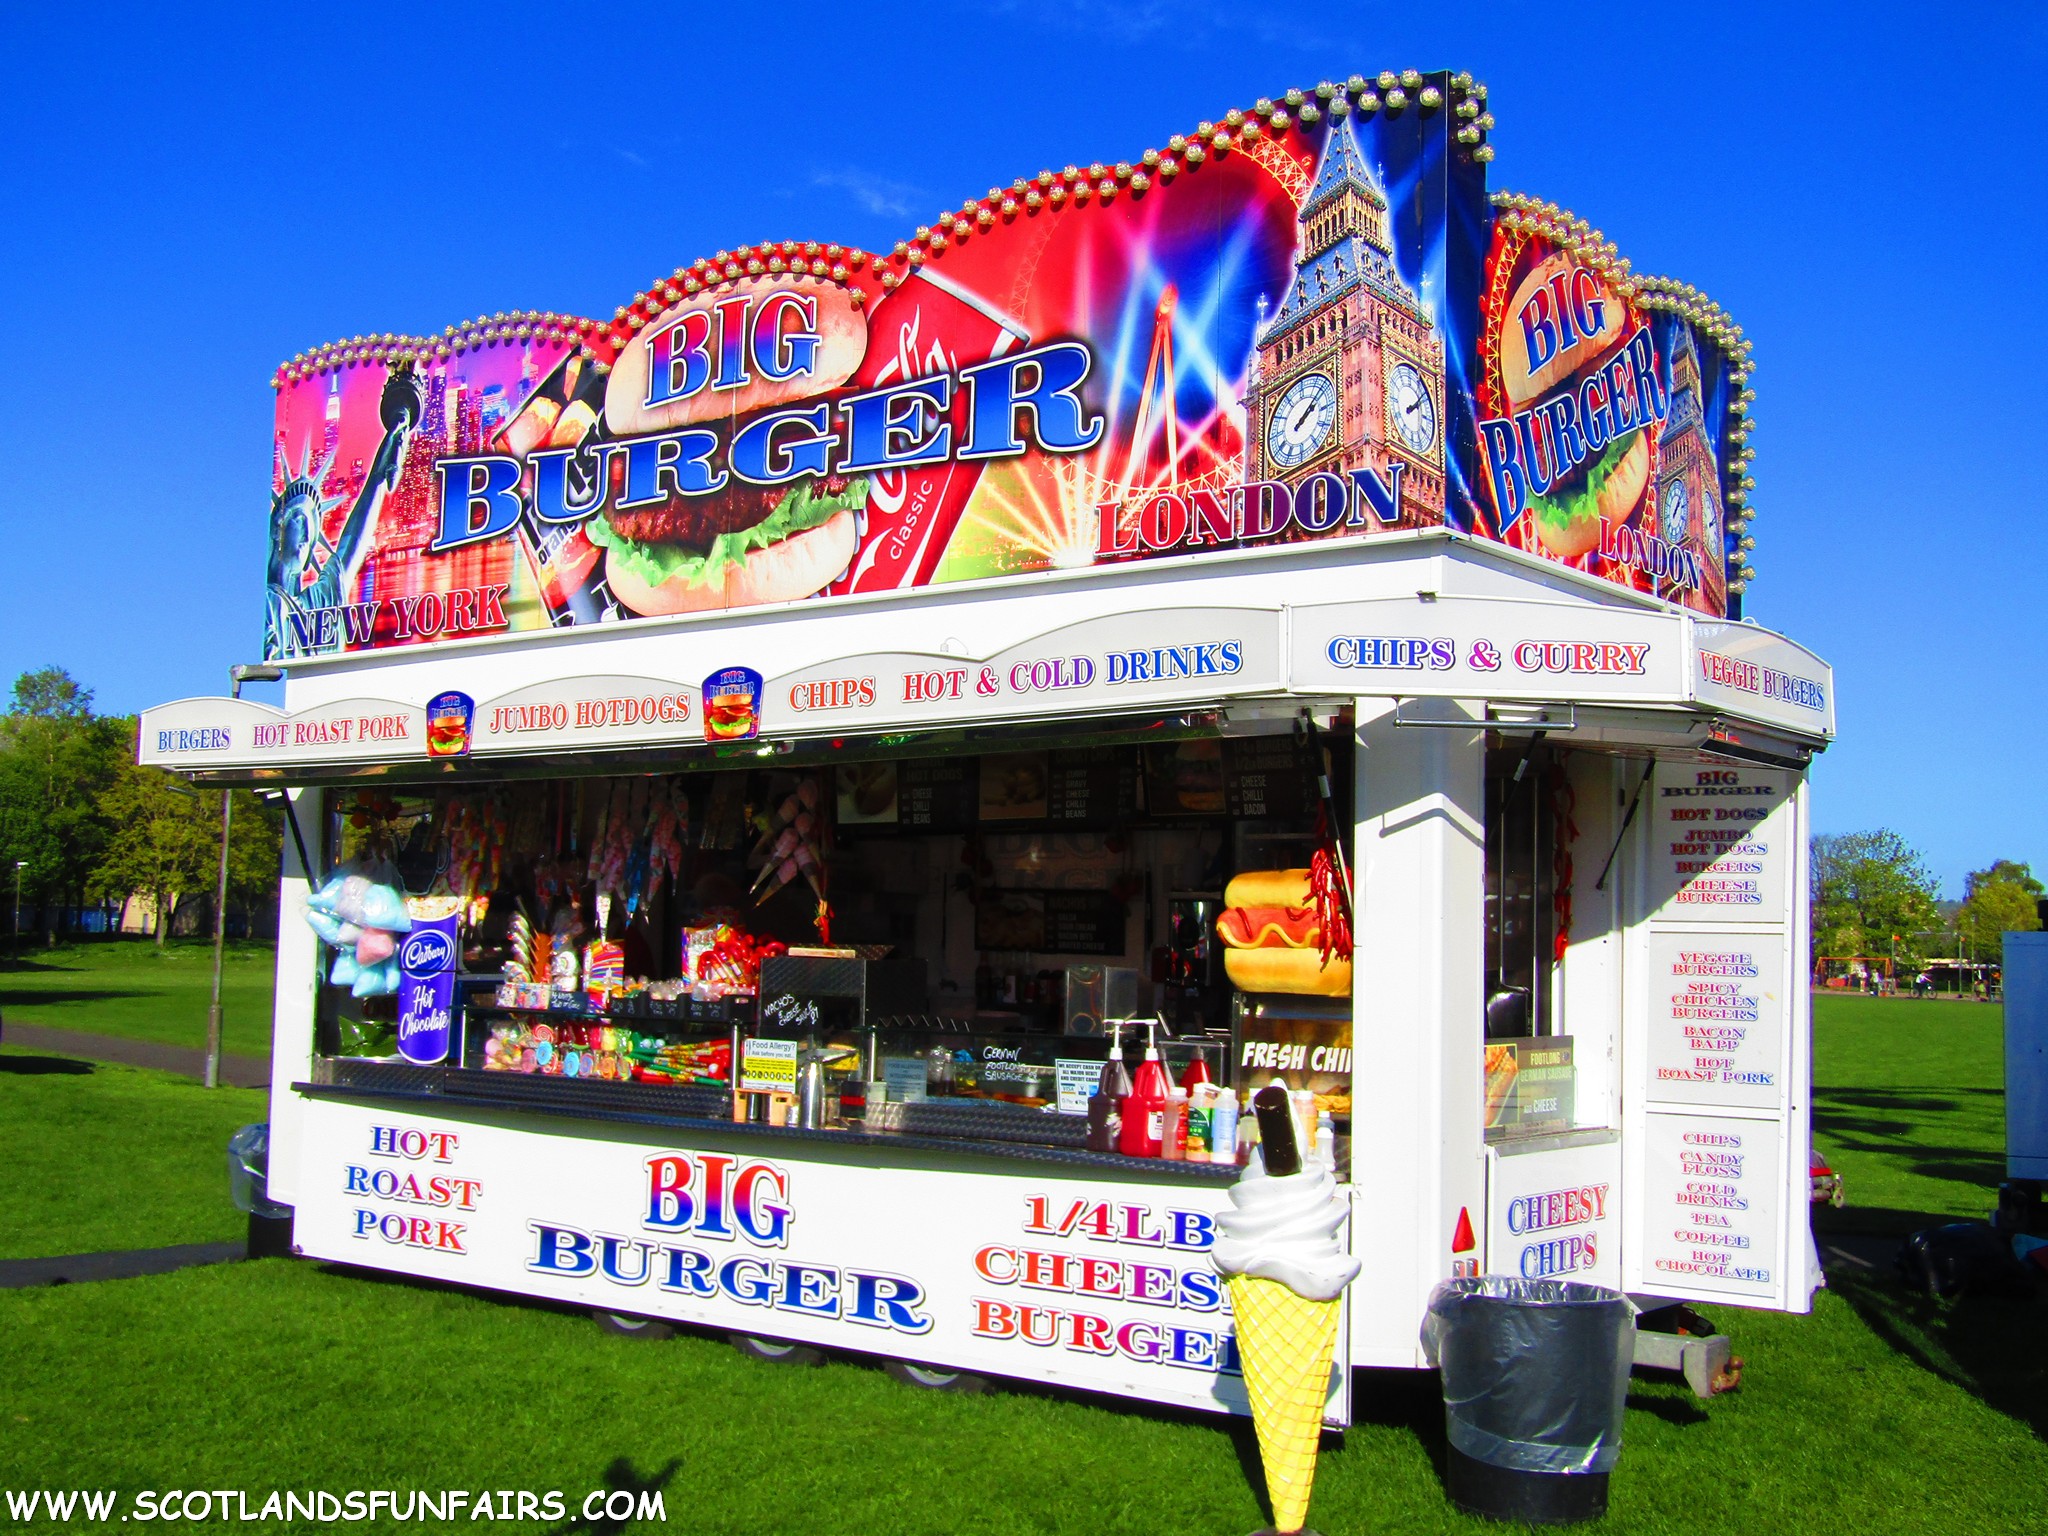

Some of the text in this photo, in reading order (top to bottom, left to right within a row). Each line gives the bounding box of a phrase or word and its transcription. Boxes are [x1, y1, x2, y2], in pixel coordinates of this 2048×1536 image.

[1518, 265, 1608, 378] BIG
[642, 291, 822, 409] BIG
[1480, 325, 1667, 538] BURGER
[431, 342, 1104, 552] BURGER
[1094, 464, 1405, 555] LONDON
[890, 480, 933, 560] classic
[1599, 515, 1701, 591] LONDON
[287, 583, 509, 651] NEW YORK
[1326, 635, 1651, 676] CHIPS & CURRY
[720, 670, 745, 684] BIG
[788, 641, 1244, 712] CHIPS HOT & COLD DRINKS
[1698, 649, 1825, 712] VEGGIE BURGERS
[709, 681, 754, 699] BURGER
[489, 694, 690, 732] JUMBO HOTDOGS
[157, 714, 410, 751] BURGERS HOT ROAST PORK
[1241, 775, 1267, 788] CHEESE
[1696, 771, 1739, 786] BIG
[1242, 789, 1263, 801] CHILLI
[1661, 786, 1776, 798] BURGER
[1065, 809, 1087, 819] BEANS
[1244, 803, 1267, 816] BACON
[1670, 807, 1768, 821] HOT DOGS
[912, 813, 931, 824] BEANS
[1684, 829, 1753, 842] JUMBO
[1670, 842, 1768, 855] HOT DOGS
[1675, 861, 1763, 874] BURGERS
[1681, 879, 1757, 892] CHEESE
[1675, 891, 1762, 904] BURGERS
[405, 942, 446, 969] Cadbury
[1680, 952, 1752, 966] VEGGIE
[1671, 964, 1758, 977] BURGERS
[1687, 982, 1741, 995] SPICY
[413, 985, 436, 1014] Hot
[1671, 994, 1758, 1008] CHICKEN
[778, 1002, 801, 1026] CHEESE
[795, 1000, 814, 1025] SAUCE
[1671, 1007, 1758, 1021] BURGERS
[400, 1009, 448, 1040] Chocolate
[1682, 1025, 1746, 1040] BACON
[752, 1041, 795, 1052] Food Allergy?
[1689, 1039, 1739, 1051] BAPP
[983, 1046, 1021, 1061] GERMAN
[1242, 1041, 1306, 1070] FRESH
[1530, 1052, 1561, 1065] FOOTLONG
[985, 1061, 1027, 1072] FOOTLONG
[1695, 1057, 1734, 1070] HOT
[985, 1071, 1023, 1082] SAUSAGE
[1520, 1066, 1572, 1082] GERMAN SAUSAGE
[1656, 1068, 1774, 1085] ROAST PORK
[1533, 1098, 1557, 1112] CHEESE
[369, 1123, 459, 1163] HOT
[1683, 1132, 1741, 1147] CHIPS
[1679, 1151, 1744, 1167] CANDY
[1681, 1163, 1742, 1178] FLOSS
[344, 1163, 483, 1211] ROAST
[1686, 1182, 1737, 1197] COLD
[643, 1150, 794, 1249] BIG
[1675, 1193, 1749, 1210] DRINKS
[1508, 1183, 1608, 1236] CHEESY
[1022, 1193, 1218, 1252] 1/4LB
[1690, 1213, 1731, 1227] TEA
[352, 1207, 468, 1255] PORK
[1674, 1230, 1749, 1248] COFFEE
[1520, 1231, 1597, 1279] CHIPS
[1692, 1250, 1731, 1265] HOT
[525, 1218, 935, 1337] BURGER
[972, 1242, 1235, 1315] CHEES
[1655, 1259, 1770, 1282] CHOCOLATE
